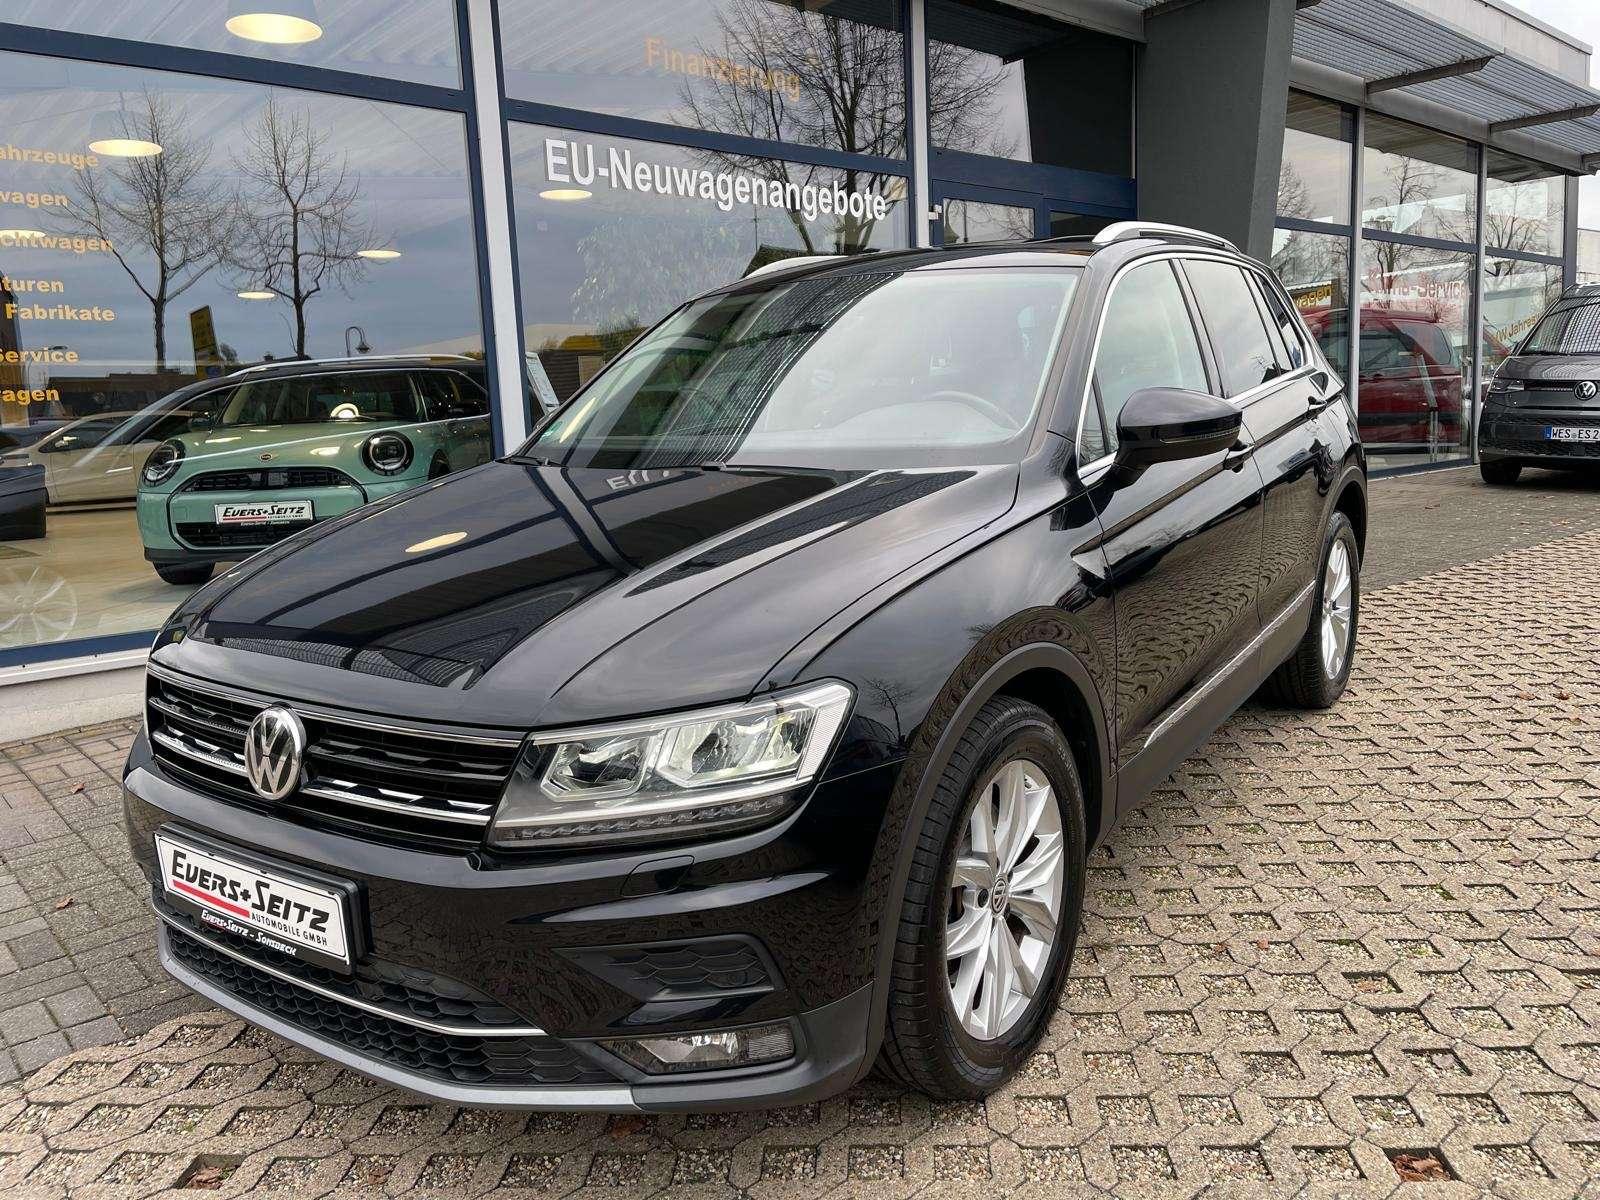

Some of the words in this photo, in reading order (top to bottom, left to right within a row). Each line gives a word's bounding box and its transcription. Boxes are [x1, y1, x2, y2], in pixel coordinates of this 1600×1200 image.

[544, 138, 888, 221] EU-Neuwagenangebote
[0, 276, 65, 292] turen
[5, 302, 117, 321] Fabrikate
[0, 388, 60, 405] agen
[1552, 428, 1571, 439] WES
[171, 849, 330, 933] EVERS+SEITZ
[251, 912, 301, 937] AUTOMOBILE
